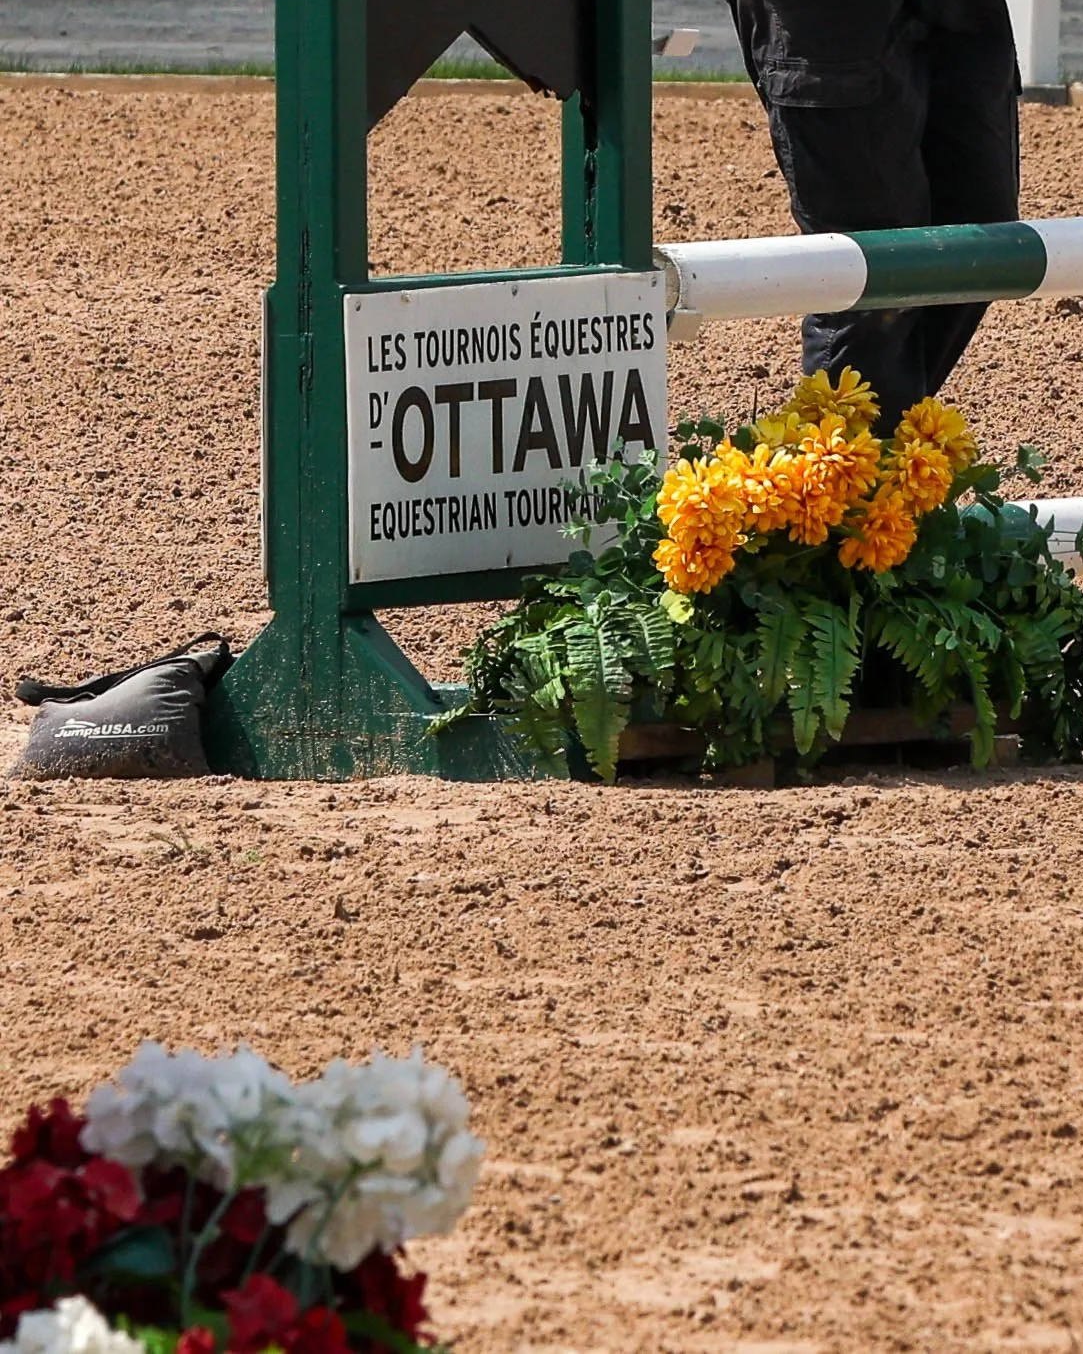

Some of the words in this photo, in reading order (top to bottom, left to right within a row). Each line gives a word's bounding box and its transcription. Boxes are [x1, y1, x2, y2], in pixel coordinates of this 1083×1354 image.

[368, 333, 407, 373] LES
[414, 323, 522, 369] TOURNOIS
[530, 311, 655, 360] ÉQUESTRES
[370, 491, 498, 543] EQUESTRIAN
[54, 723, 169, 738] JumpsUSA.com
